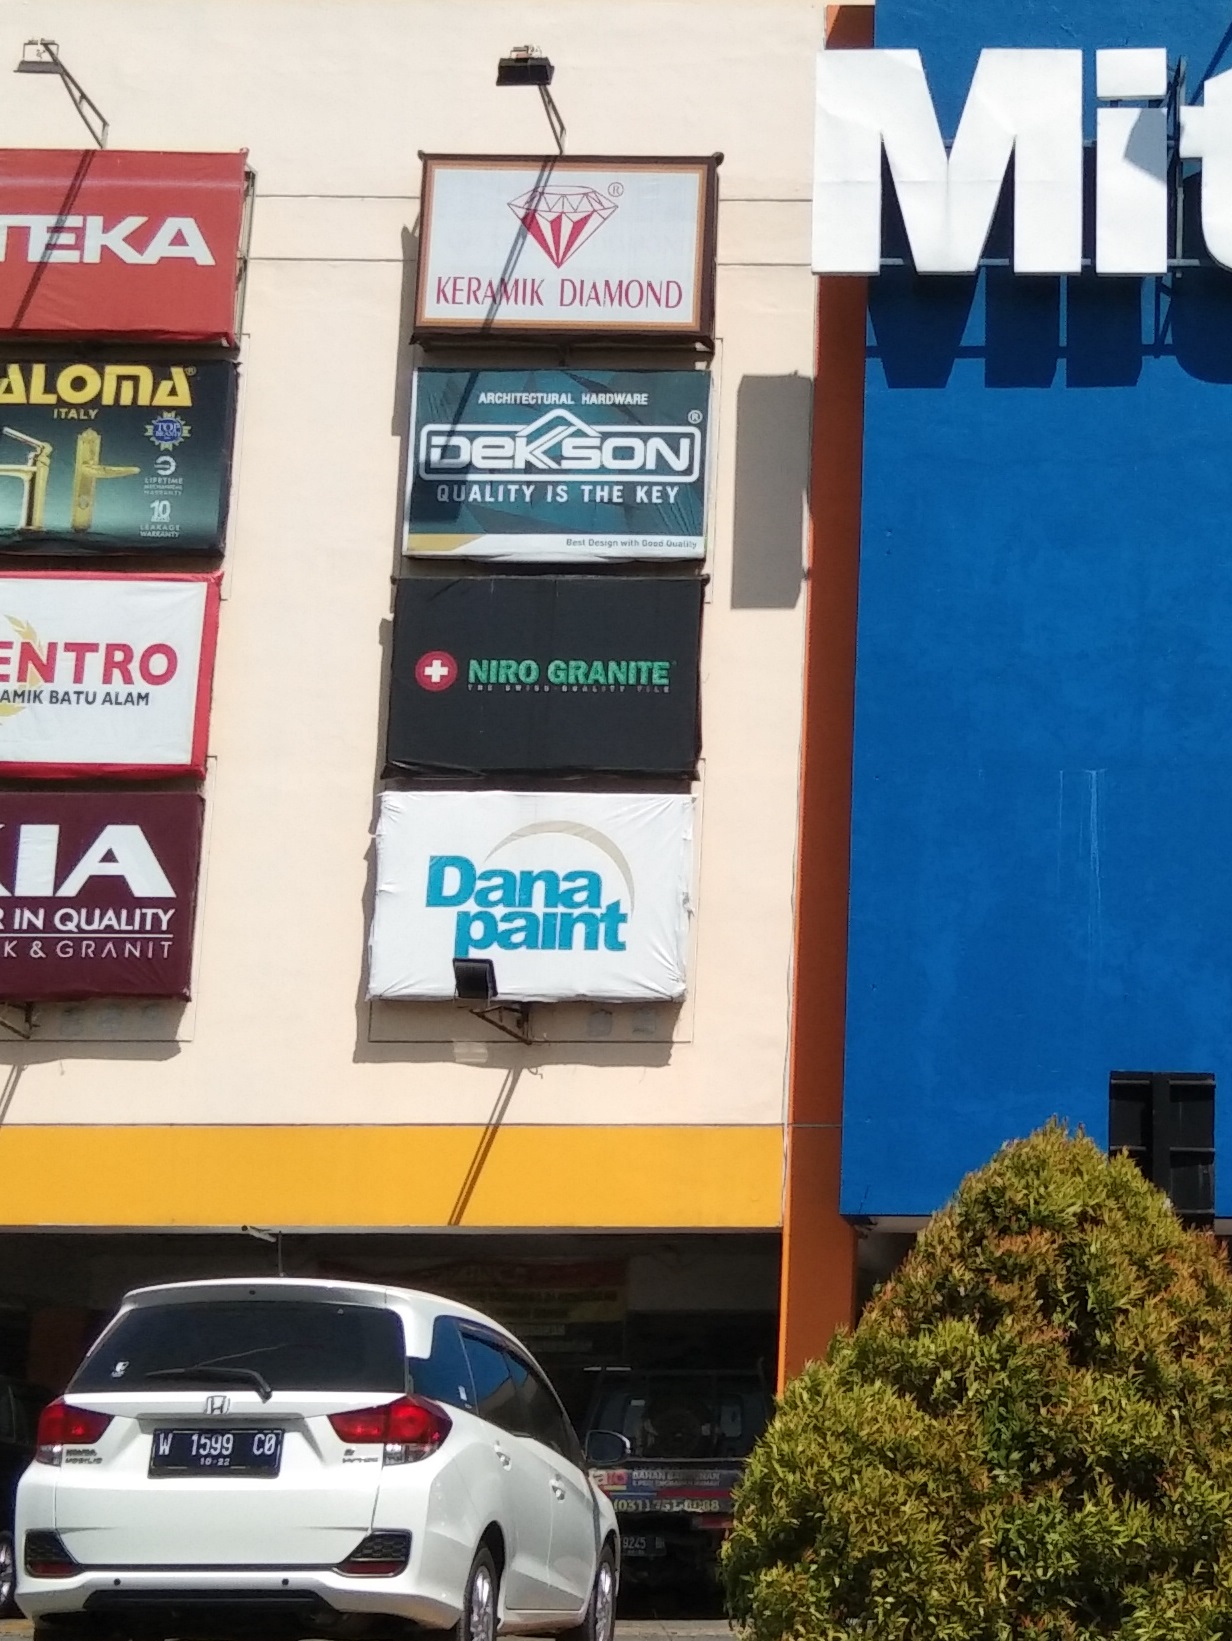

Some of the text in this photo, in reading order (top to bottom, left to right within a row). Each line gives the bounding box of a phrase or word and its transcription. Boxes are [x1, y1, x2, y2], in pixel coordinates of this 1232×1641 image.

[436, 276, 683, 309] KERAMIK DIAMOND
[0, 363, 192, 407] ALOMA
[478, 393, 648, 405] ARCHITECTURAL HARDWARE
[53, 408, 99, 419] ITALY
[157, 422, 180, 432] TOP
[437, 485, 679, 504] QUALITY IS THE KEY
[150, 500, 171, 519] 10
[566, 538, 697, 549] Best Design with Good Quality
[468, 659, 670, 685] NIRO GRANITE
[0, 689, 150, 706] AMIK BATU ALAM
[0, 824, 177, 898] IA
[425, 855, 603, 909] Dana
[14, 908, 44, 930] IN
[54, 908, 176, 932] QUALITY
[454, 899, 628, 958] paint
[29, 940, 46, 958] &
[56, 940, 173, 959] GRANIT
[159, 1433, 172, 1455] W
[191, 1433, 233, 1455] 1599
